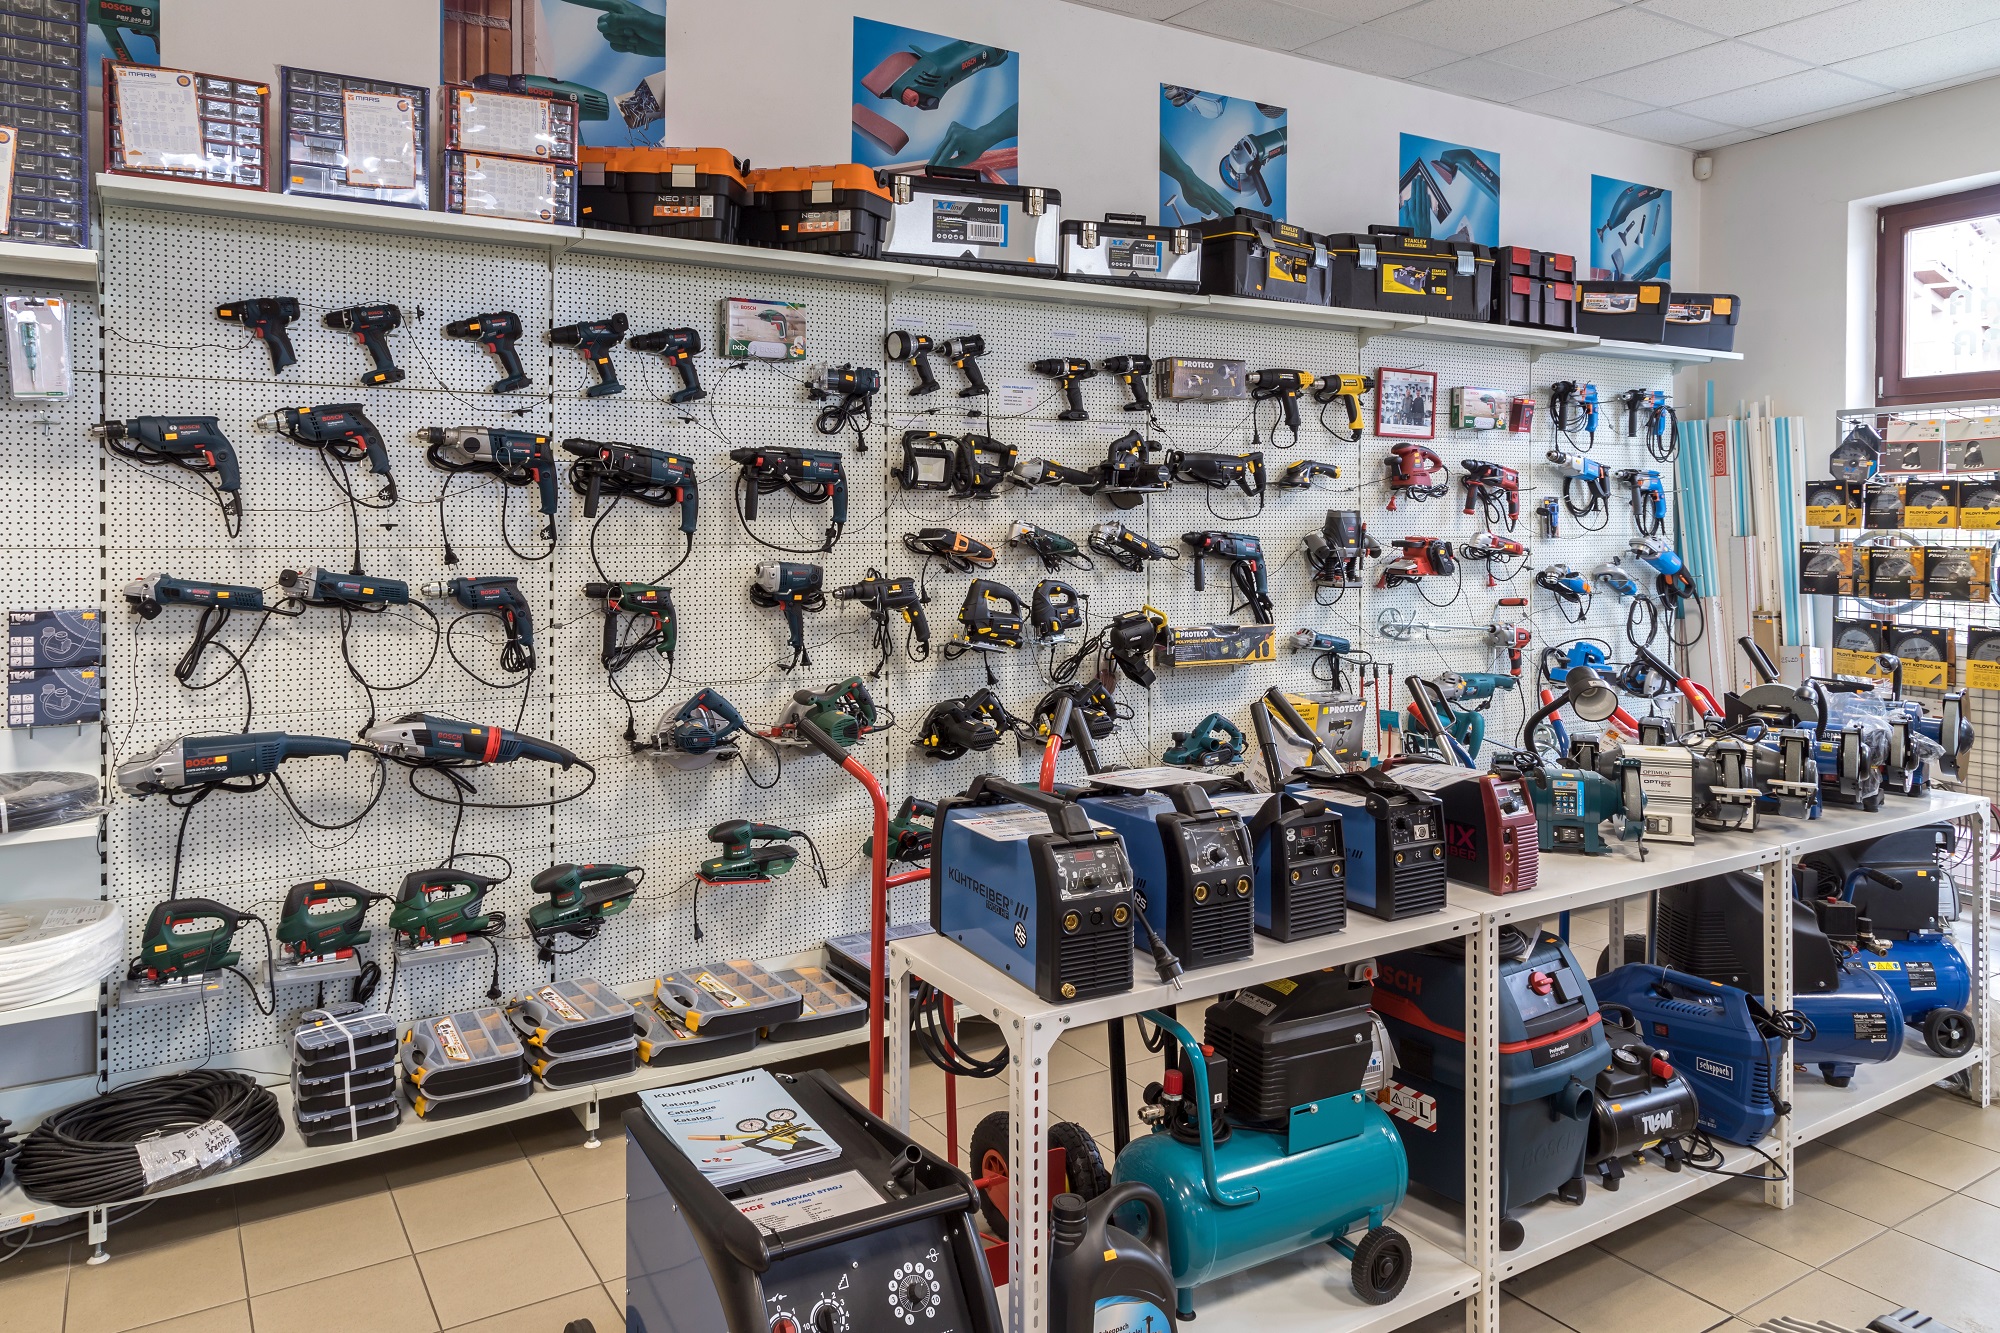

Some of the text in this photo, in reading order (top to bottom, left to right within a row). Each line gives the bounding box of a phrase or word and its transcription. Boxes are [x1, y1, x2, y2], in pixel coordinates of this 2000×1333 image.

[101, 2, 132, 12] BOSCH
[962, 57, 976, 70] BOSCH
[528, 87, 554, 98] BOSCH
[355, 95, 380, 103] MARS
[1281, 224, 1298, 232] STANLEY
[1184, 361, 1214, 369] PROTECO
[10, 612, 35, 622] TUSON
[10, 670, 35, 680] TUSON
[1330, 704, 1363, 713] PROTECO
[438, 732, 462, 740] BOSCH
[186, 757, 221, 767] BOSC
[1134, 892, 1147, 910] RS
[438, 912, 458, 923] BOSCH
[318, 926, 340, 938] BOSCH
[1015, 925, 1027, 944] RS
[183, 948, 205, 958] BOSCH
[1256, 998, 1272, 1008] 2400
[1549, 1043, 1569, 1054] Professional
[1700, 1060, 1730, 1077] scheppach
[661, 1099, 700, 1108] Katalog
[667, 1105, 716, 1116] Catalogue
[1420, 1102, 1428, 1119] L
[673, 1114, 712, 1124] Katalog
[1642, 1110, 1672, 1134] TUSON
[741, 1184, 842, 1213] KCE SVAŘOVACÍ STROJ
